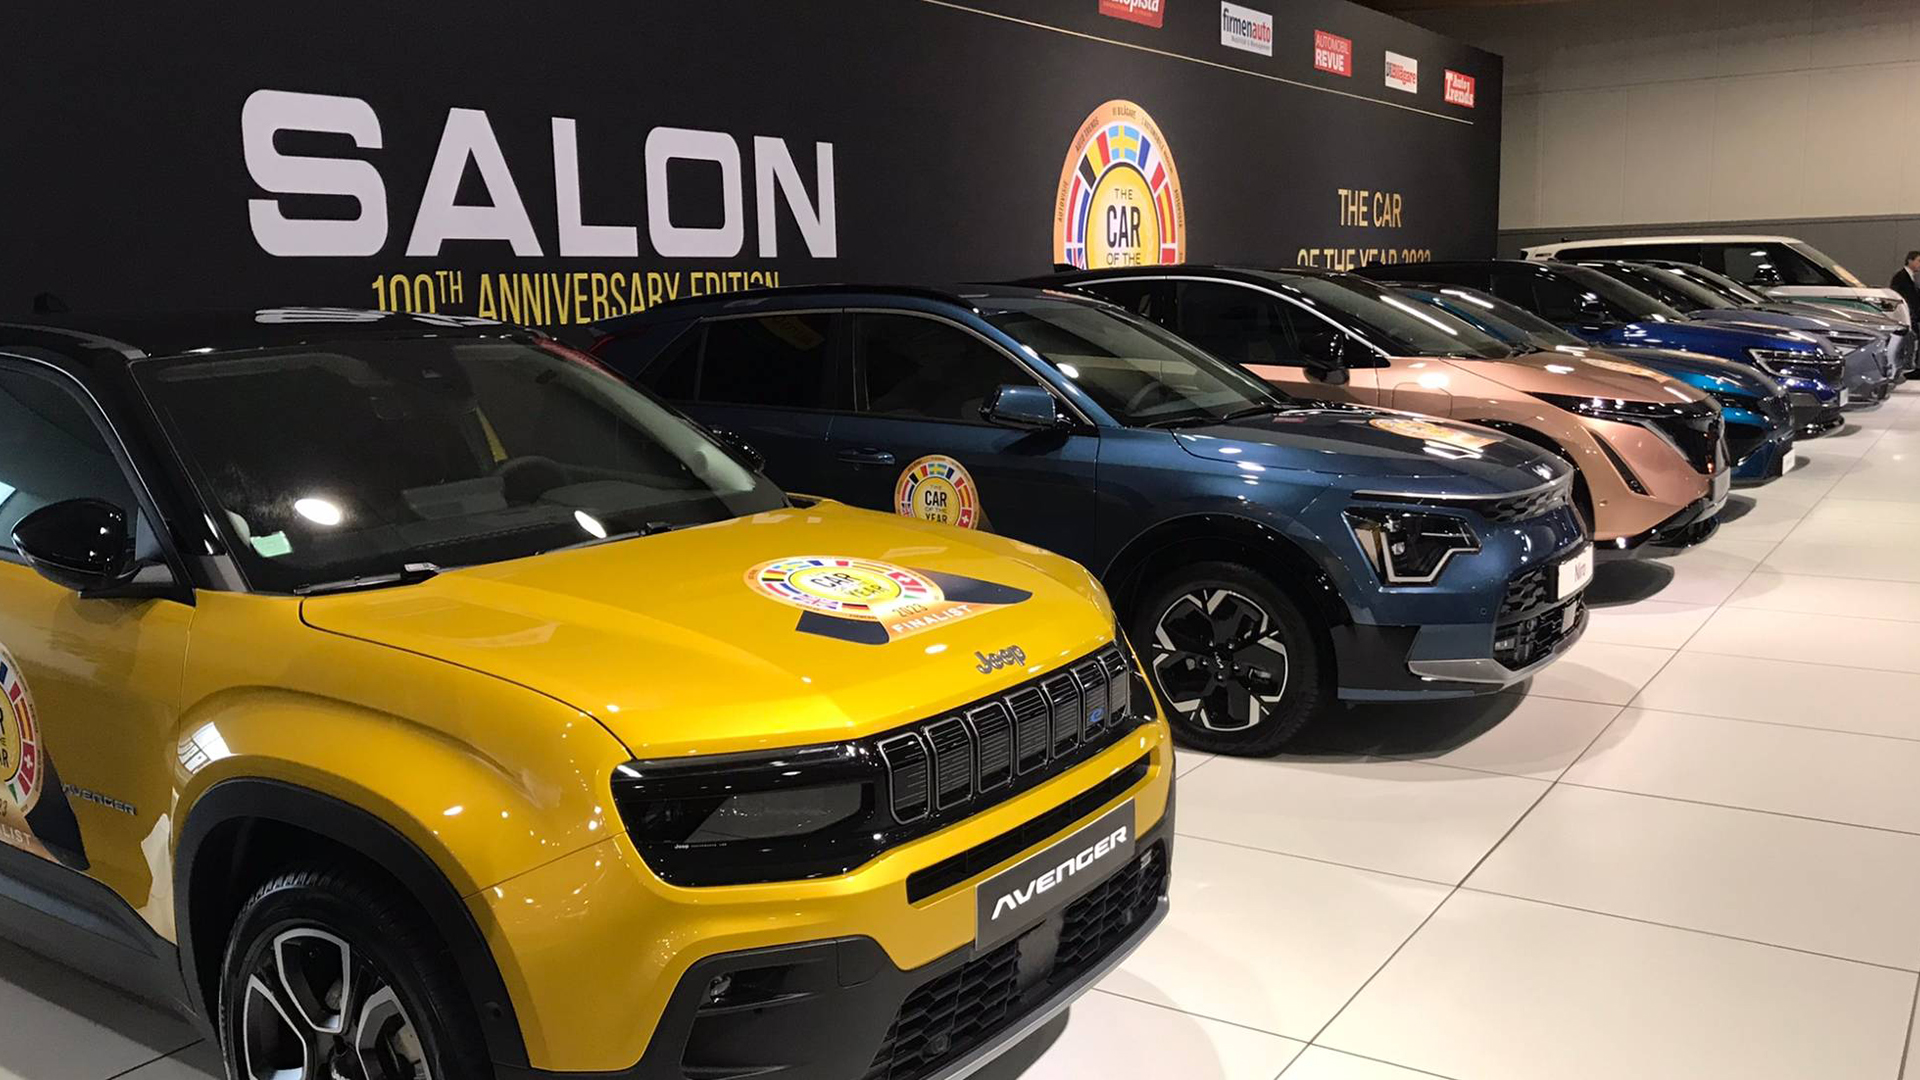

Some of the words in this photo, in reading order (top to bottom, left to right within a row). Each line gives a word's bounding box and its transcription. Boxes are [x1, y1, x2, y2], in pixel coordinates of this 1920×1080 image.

[1223, 8, 1271, 43] firmenauto
[1315, 48, 1344, 72] REVUE
[241, 89, 837, 257] SALON
[1114, 188, 1133, 201] THE
[1338, 188, 1369, 227] THE
[1373, 191, 1402, 228] CAR
[1106, 204, 1141, 249] CAR
[1106, 252, 1120, 266] OF
[1122, 253, 1142, 266] THE
[477, 271, 680, 326] ANNIVERSARY
[924, 490, 948, 508] CAR
[810, 572, 858, 589] CAR
[892, 603, 928, 618] 2023
[892, 604, 973, 633] FINALIST
[974, 644, 1027, 675] Jeep
[62, 783, 138, 817] AVENGER
[991, 825, 1127, 921] AVENGER
